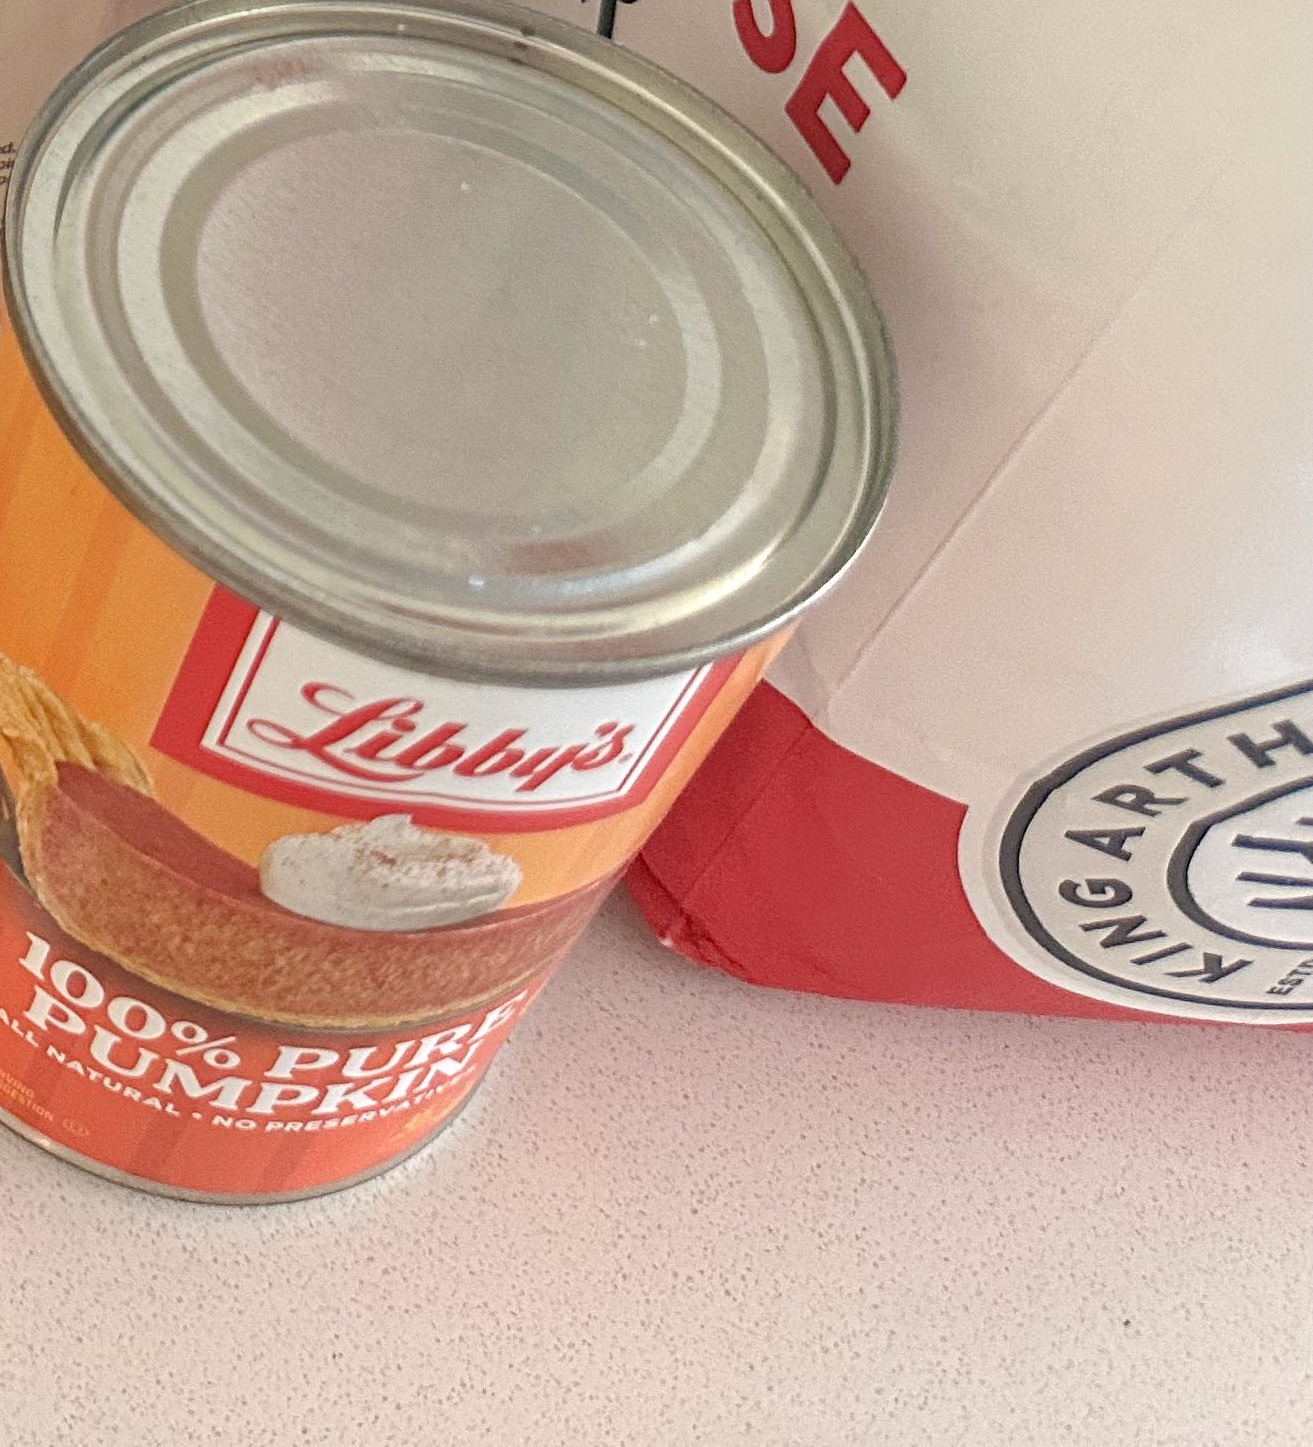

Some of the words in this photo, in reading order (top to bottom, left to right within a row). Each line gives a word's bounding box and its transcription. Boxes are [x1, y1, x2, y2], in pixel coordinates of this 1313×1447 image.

[250, 679, 626, 791] Libby's
[1058, 878, 1254, 984] KING
[18, 929, 242, 1070] 100%
[271, 990, 527, 1080] PURE
[24, 985, 485, 1116] PUMPKIN
[46, 1044, 182, 1120] NATURAL
[212, 1115, 256, 1131] NO
